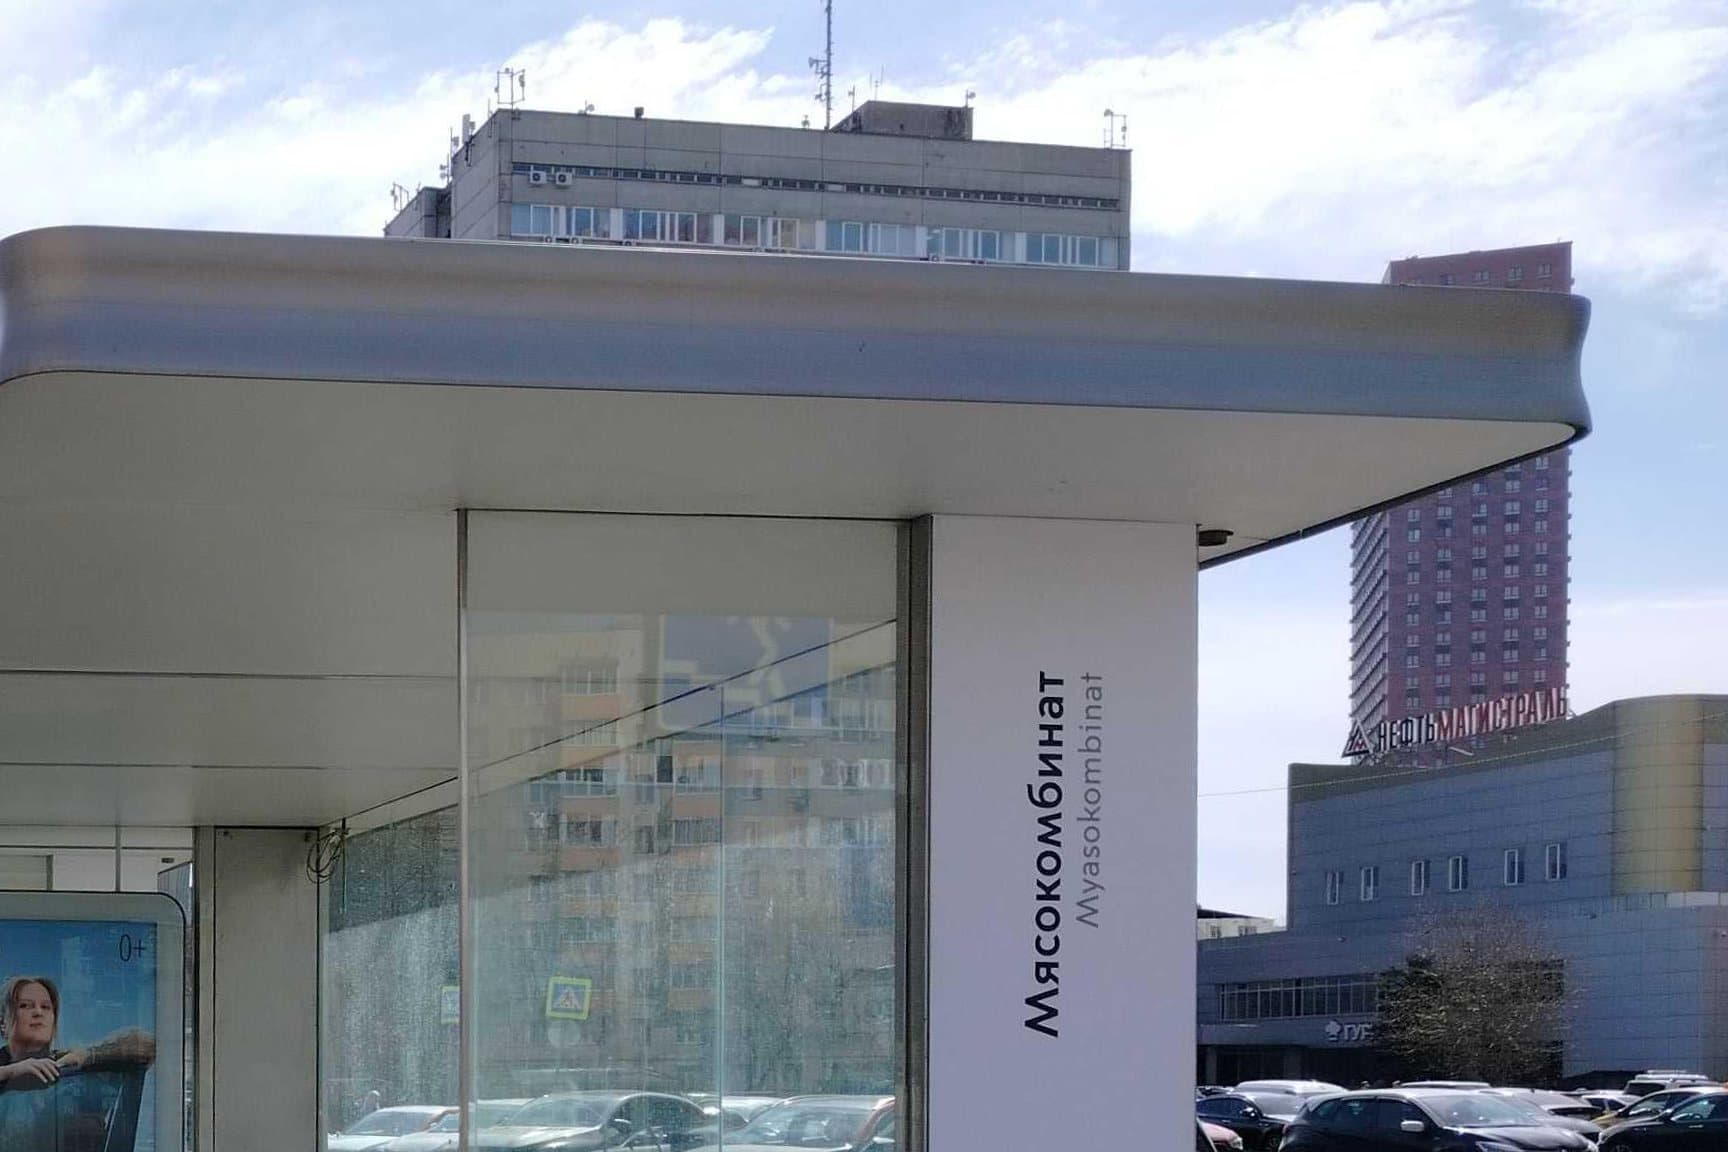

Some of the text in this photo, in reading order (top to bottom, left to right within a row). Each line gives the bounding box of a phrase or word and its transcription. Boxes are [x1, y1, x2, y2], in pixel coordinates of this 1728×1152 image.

[1024, 670, 1065, 1038] Мясокомбинат
[1075, 671, 1105, 930] Myasokombinat
[118, 933, 147, 962] 0+
